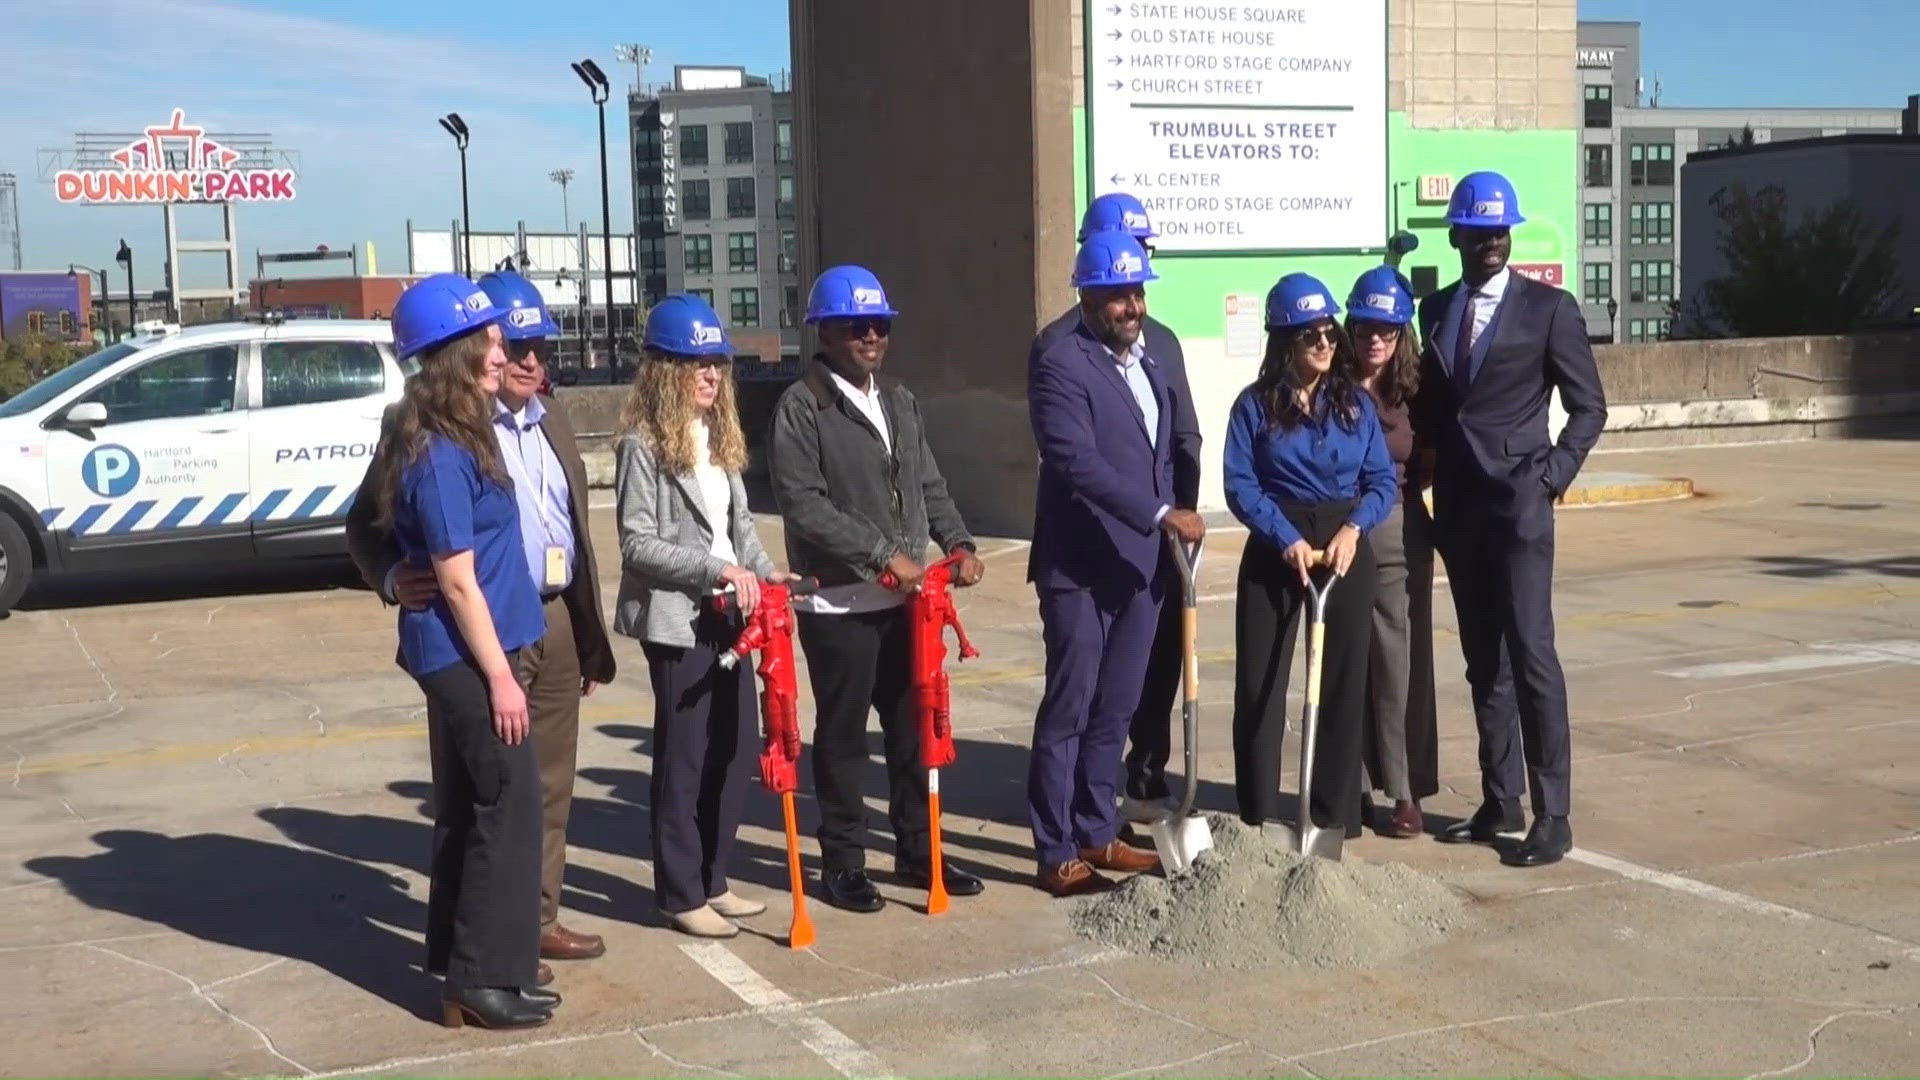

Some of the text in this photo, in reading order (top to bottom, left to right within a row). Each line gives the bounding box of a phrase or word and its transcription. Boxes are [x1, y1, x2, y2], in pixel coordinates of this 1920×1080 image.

[1130, 3, 1306, 23] STATE HOUSE SQUARE
[1131, 29, 1274, 46] OLD STATE HOUSE
[1130, 54, 1352, 72] HARTFORD STAGE COMPANY
[1131, 78, 1263, 94] CHURCH STREET
[1149, 121, 1337, 139] TRUMBULL STREET
[1169, 144, 1319, 160] ELEVATORS TO:
[56, 172, 294, 201] DUNKIN' PARK
[663, 129, 677, 228] PENNANT
[1134, 173, 1221, 187] XL CENTER
[1428, 177, 1450, 197] EXIT
[1144, 197, 1353, 212] ARTFORD STAGE COMPANY
[1157, 221, 1244, 235] TON HOTEL
[1544, 268, 1554, 281] C
[144, 446, 192, 458] Hartford
[95, 448, 131, 495] P
[173, 458, 218, 470] Parking
[145, 473, 196, 485] Authority
